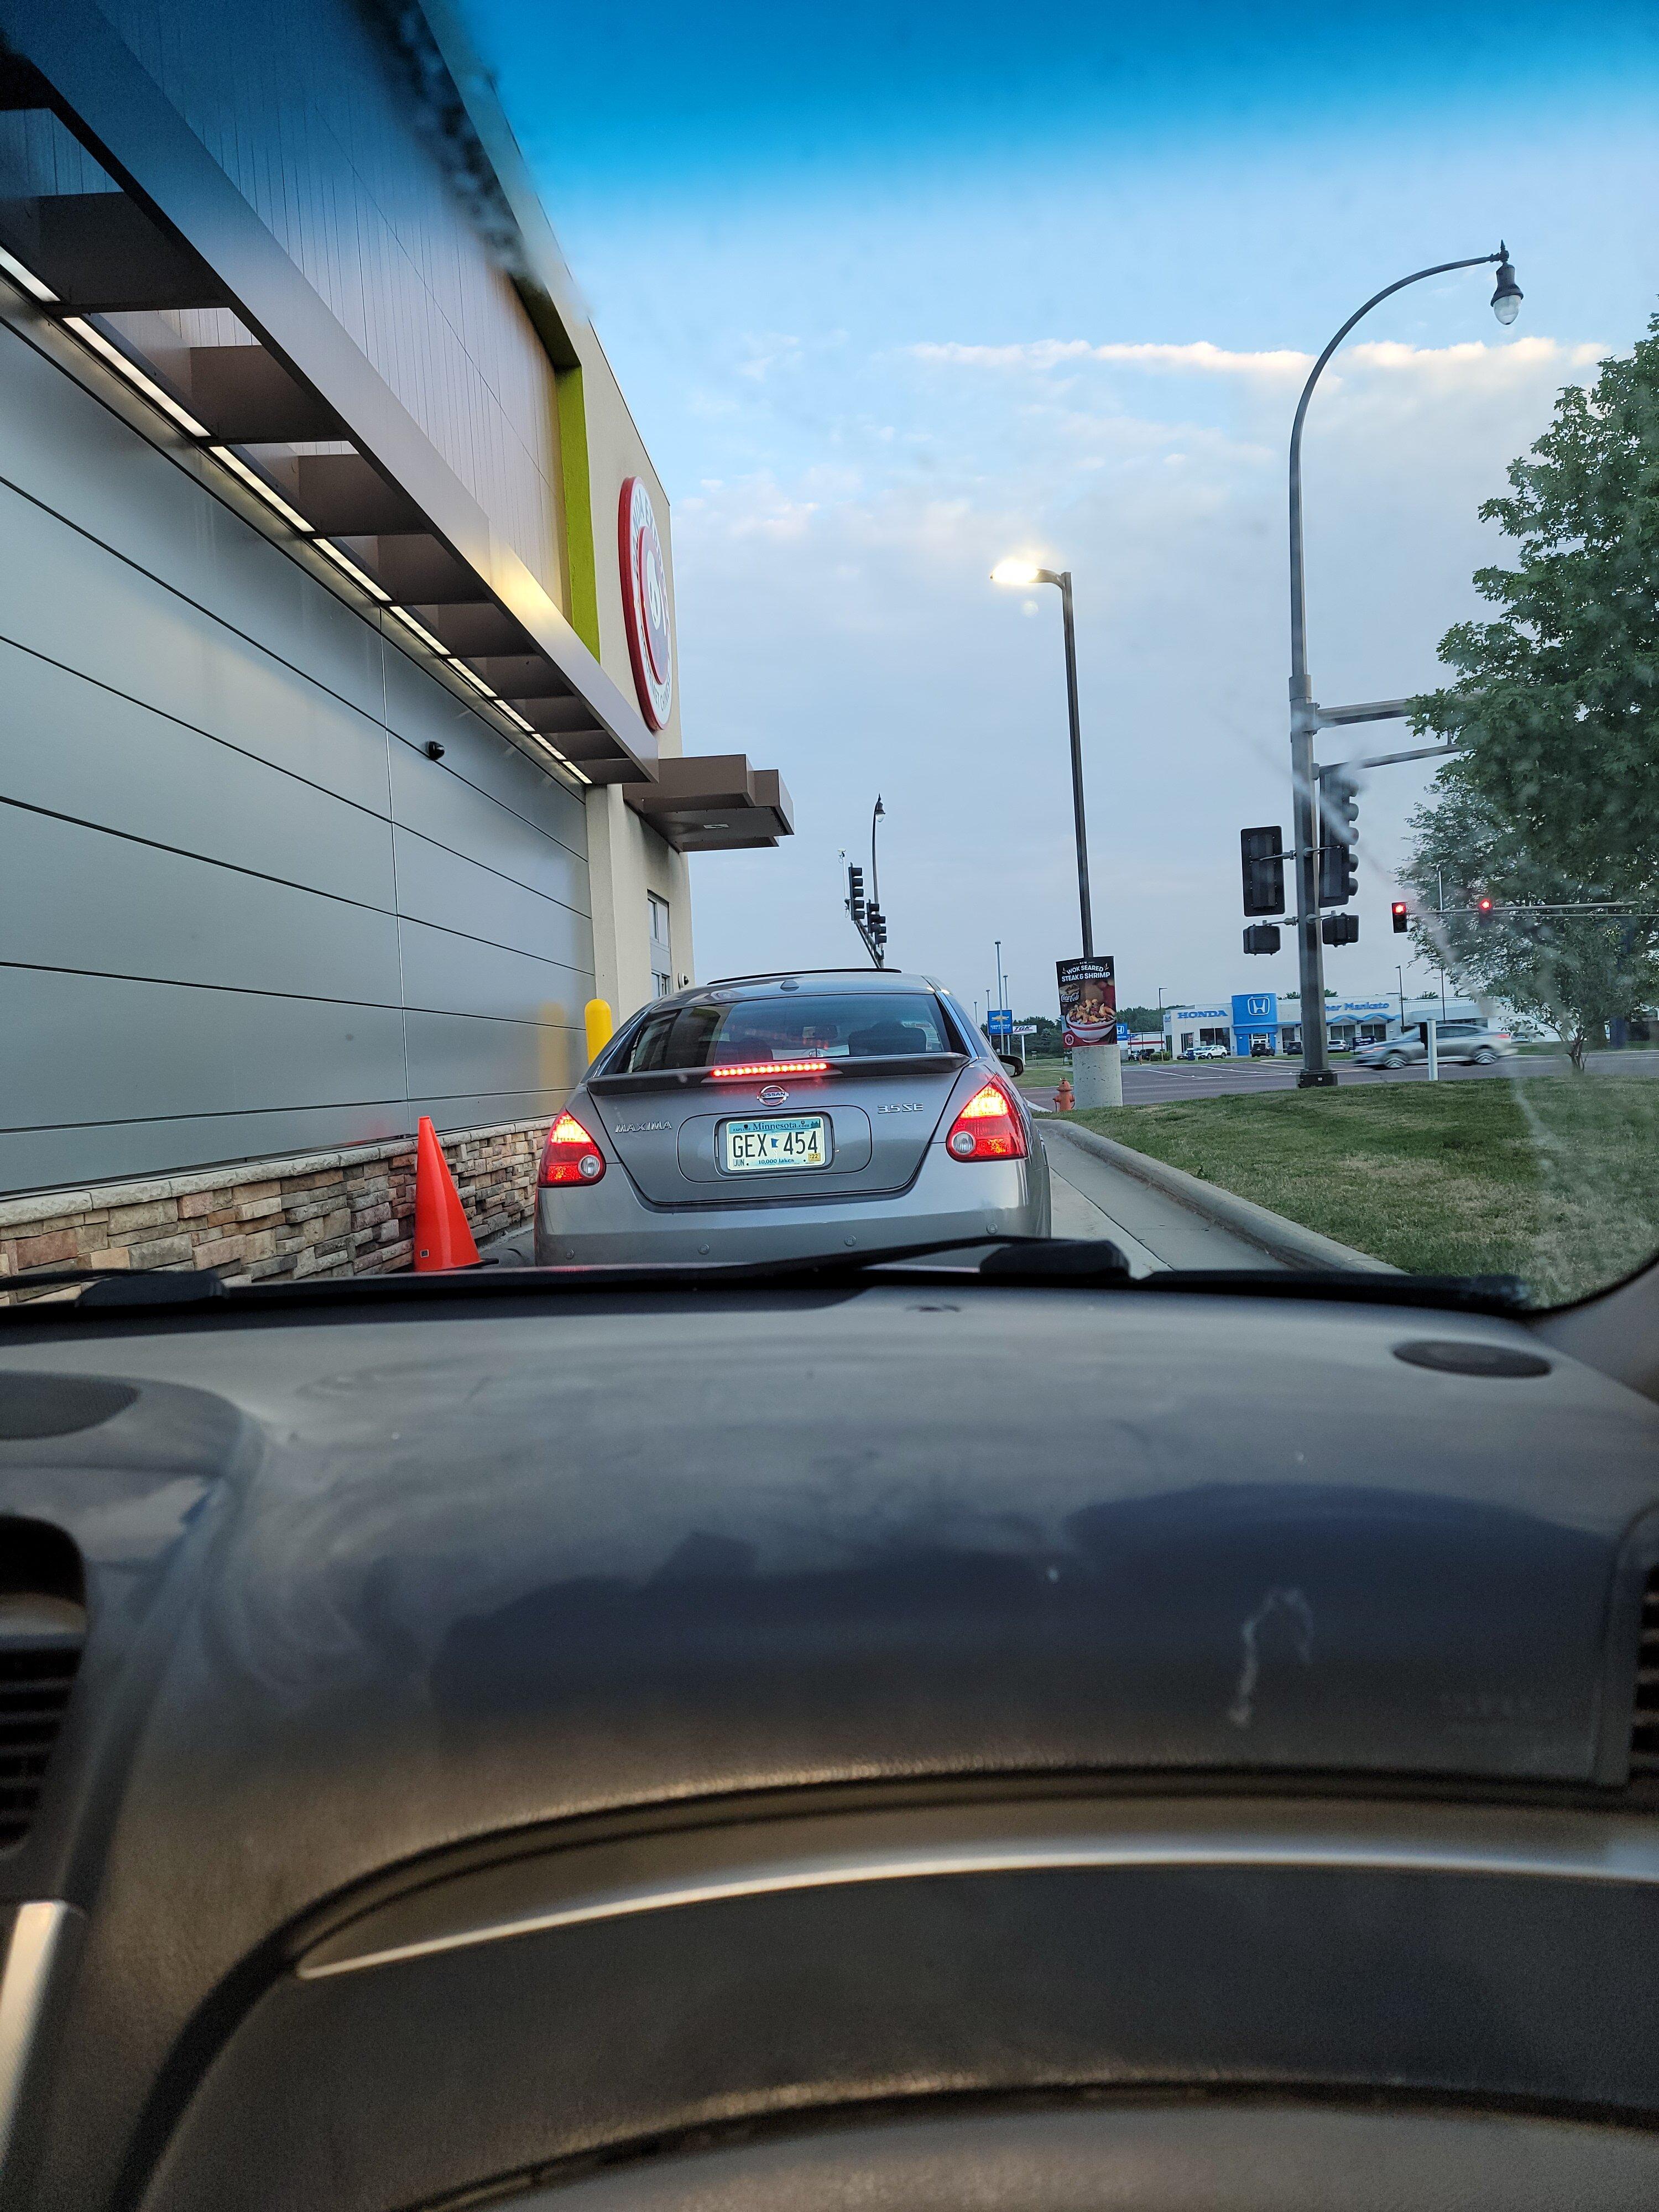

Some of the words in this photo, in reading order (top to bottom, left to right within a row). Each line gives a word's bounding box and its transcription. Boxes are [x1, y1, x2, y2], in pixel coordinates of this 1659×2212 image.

[1066, 966, 1081, 975] WOK
[1061, 974, 1079, 982] STEAK
[1344, 1001, 1390, 1011] Mankato
[1177, 1010, 1228, 1019] HONDA
[615, 1121, 672, 1133] MAXIMA
[733, 1133, 768, 1158] GEX
[783, 1130, 818, 1155] 454
